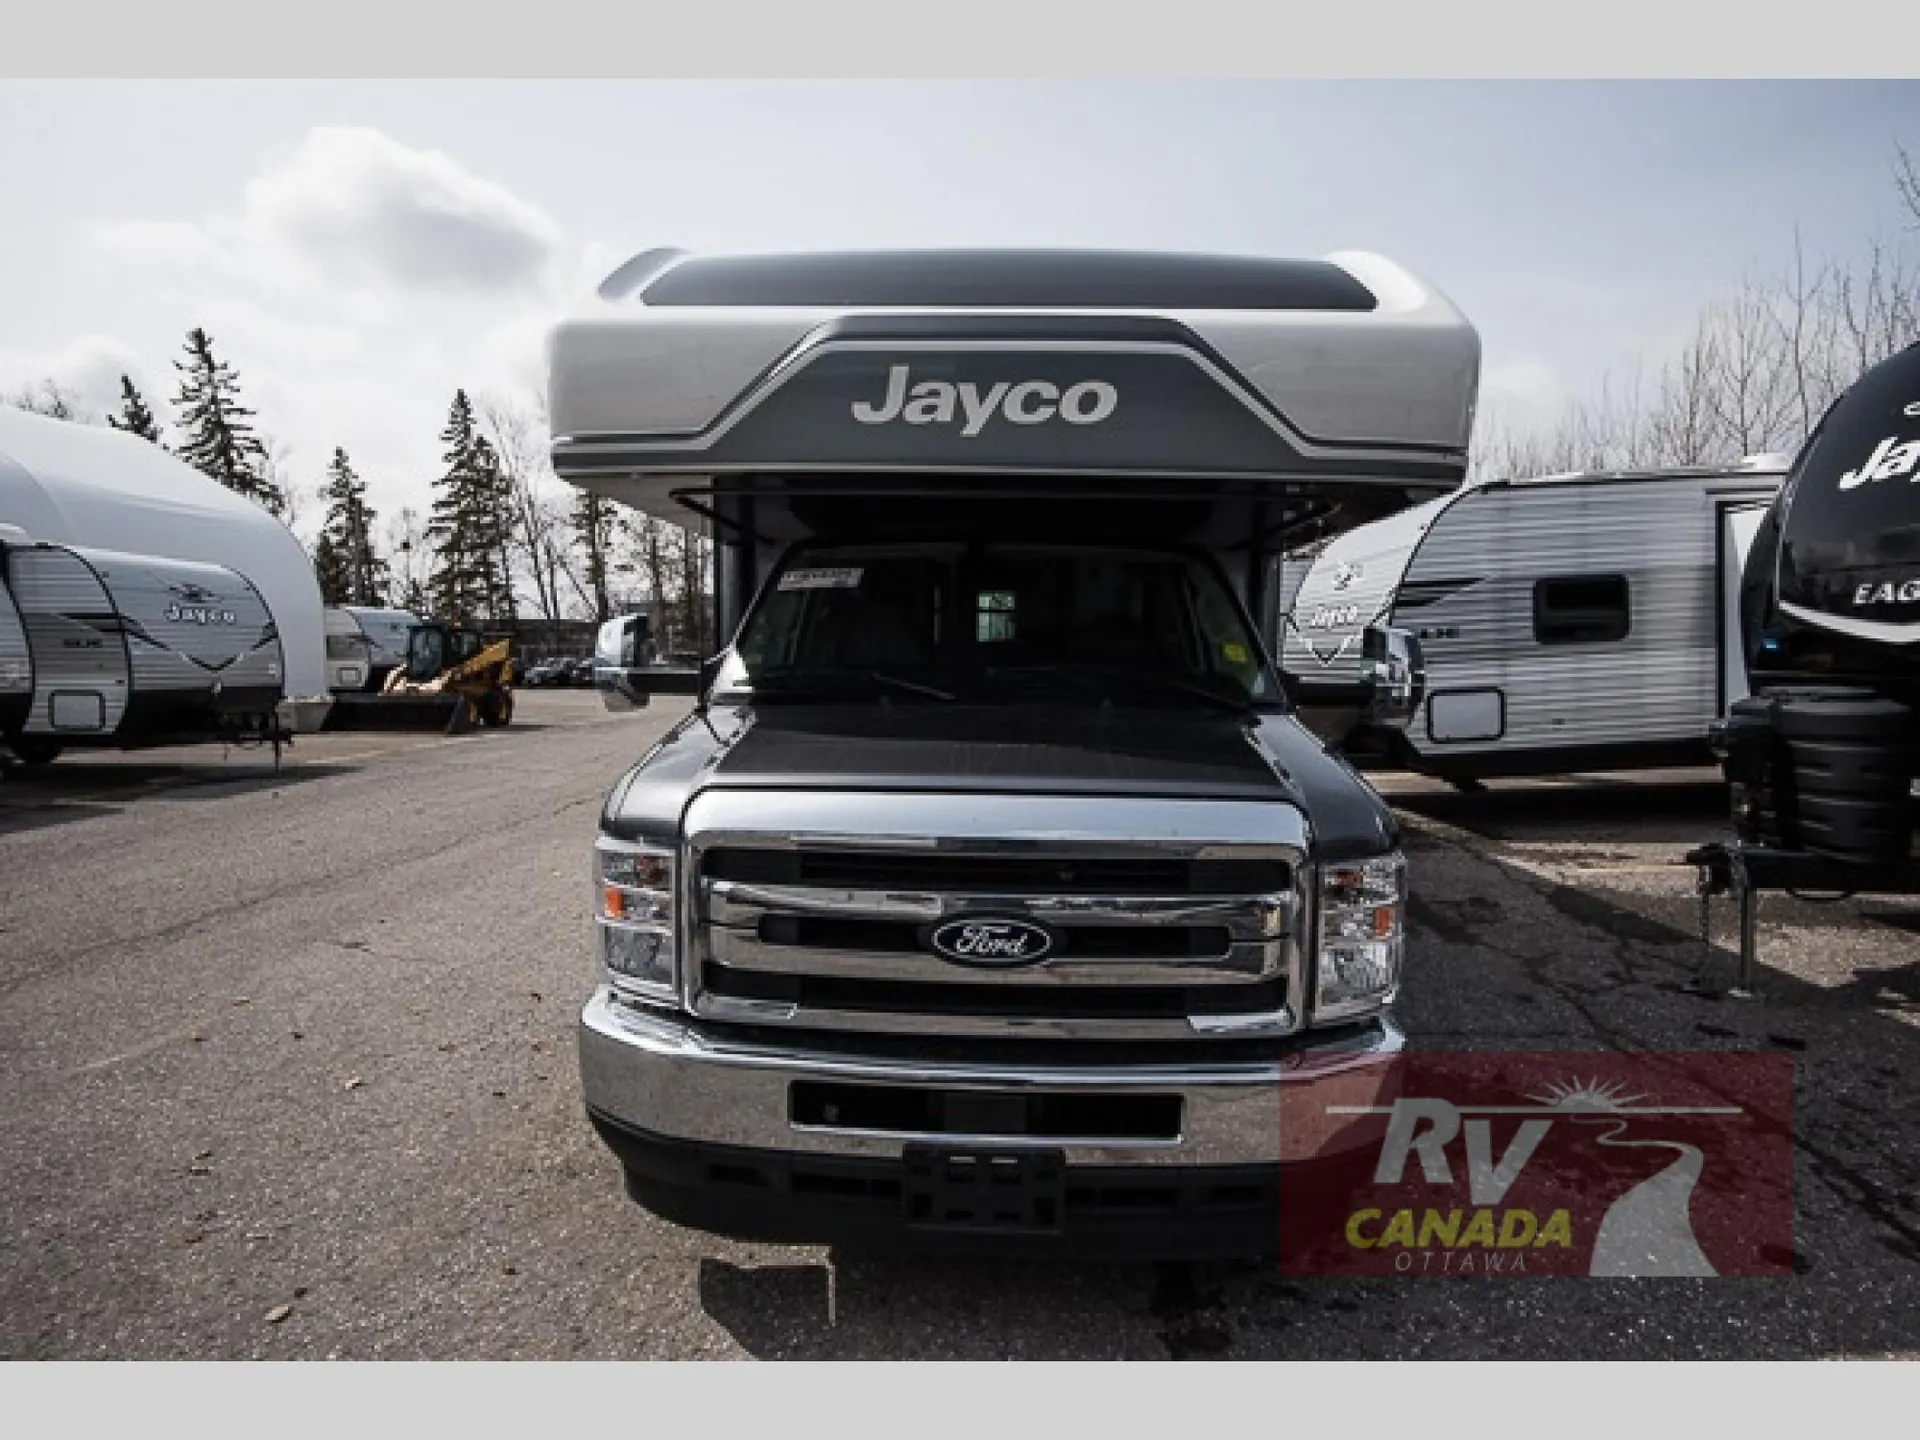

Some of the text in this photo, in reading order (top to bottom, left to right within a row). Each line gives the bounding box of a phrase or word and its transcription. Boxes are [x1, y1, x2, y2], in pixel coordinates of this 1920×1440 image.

[851, 364, 1118, 437] Jayco
[1839, 436, 1920, 489] Ja
[956, 925, 1027, 956] Ford
